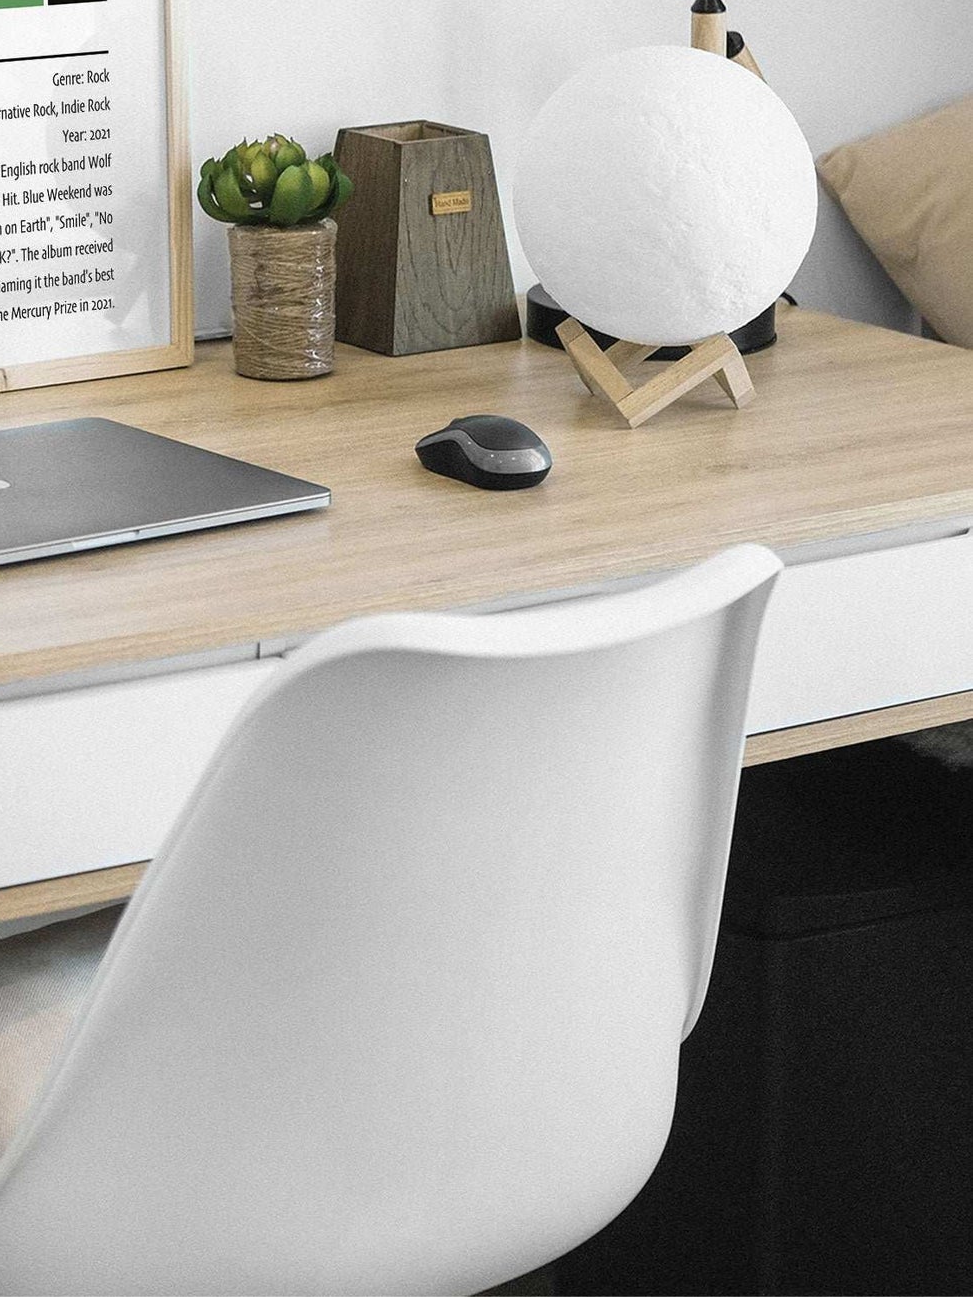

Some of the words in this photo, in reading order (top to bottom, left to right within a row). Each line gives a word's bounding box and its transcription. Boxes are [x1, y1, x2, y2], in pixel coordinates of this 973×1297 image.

[52, 72, 85, 87] Genre:
[86, 67, 111, 84] Rock
[33, 100, 59, 118] Rock,
[61, 98, 86, 115] Indie
[87, 95, 111, 113] Rock
[62, 128, 88, 144] Year:
[89, 127, 111, 141] 2021
[0, 160, 37, 182] English
[38, 157, 60, 175] rock
[61, 155, 86, 173] band
[87, 152, 113, 170] Wolf
[2, 191, 21, 207] Hit.
[22, 189, 45, 205] Blue
[46, 183, 92, 202] Weekend
[93, 184, 113, 198] was
[4, 222, 18, 236] on
[20, 215, 54, 234] Earth",
[55, 211, 93, 230] "Smile",
[94, 211, 114, 225] "No
[19, 246, 40, 262] The
[41, 243, 73, 261] album
[74, 237, 114, 257] received
[34, 275, 43, 290] it
[43, 272, 61, 289] the
[61, 268, 93, 287] band's
[94, 267, 115, 283] best
[10, 305, 53, 321] Mercury
[53, 300, 78, 316] Prize
[79, 298, 89, 313] in
[91, 298, 116, 311] 2021.
